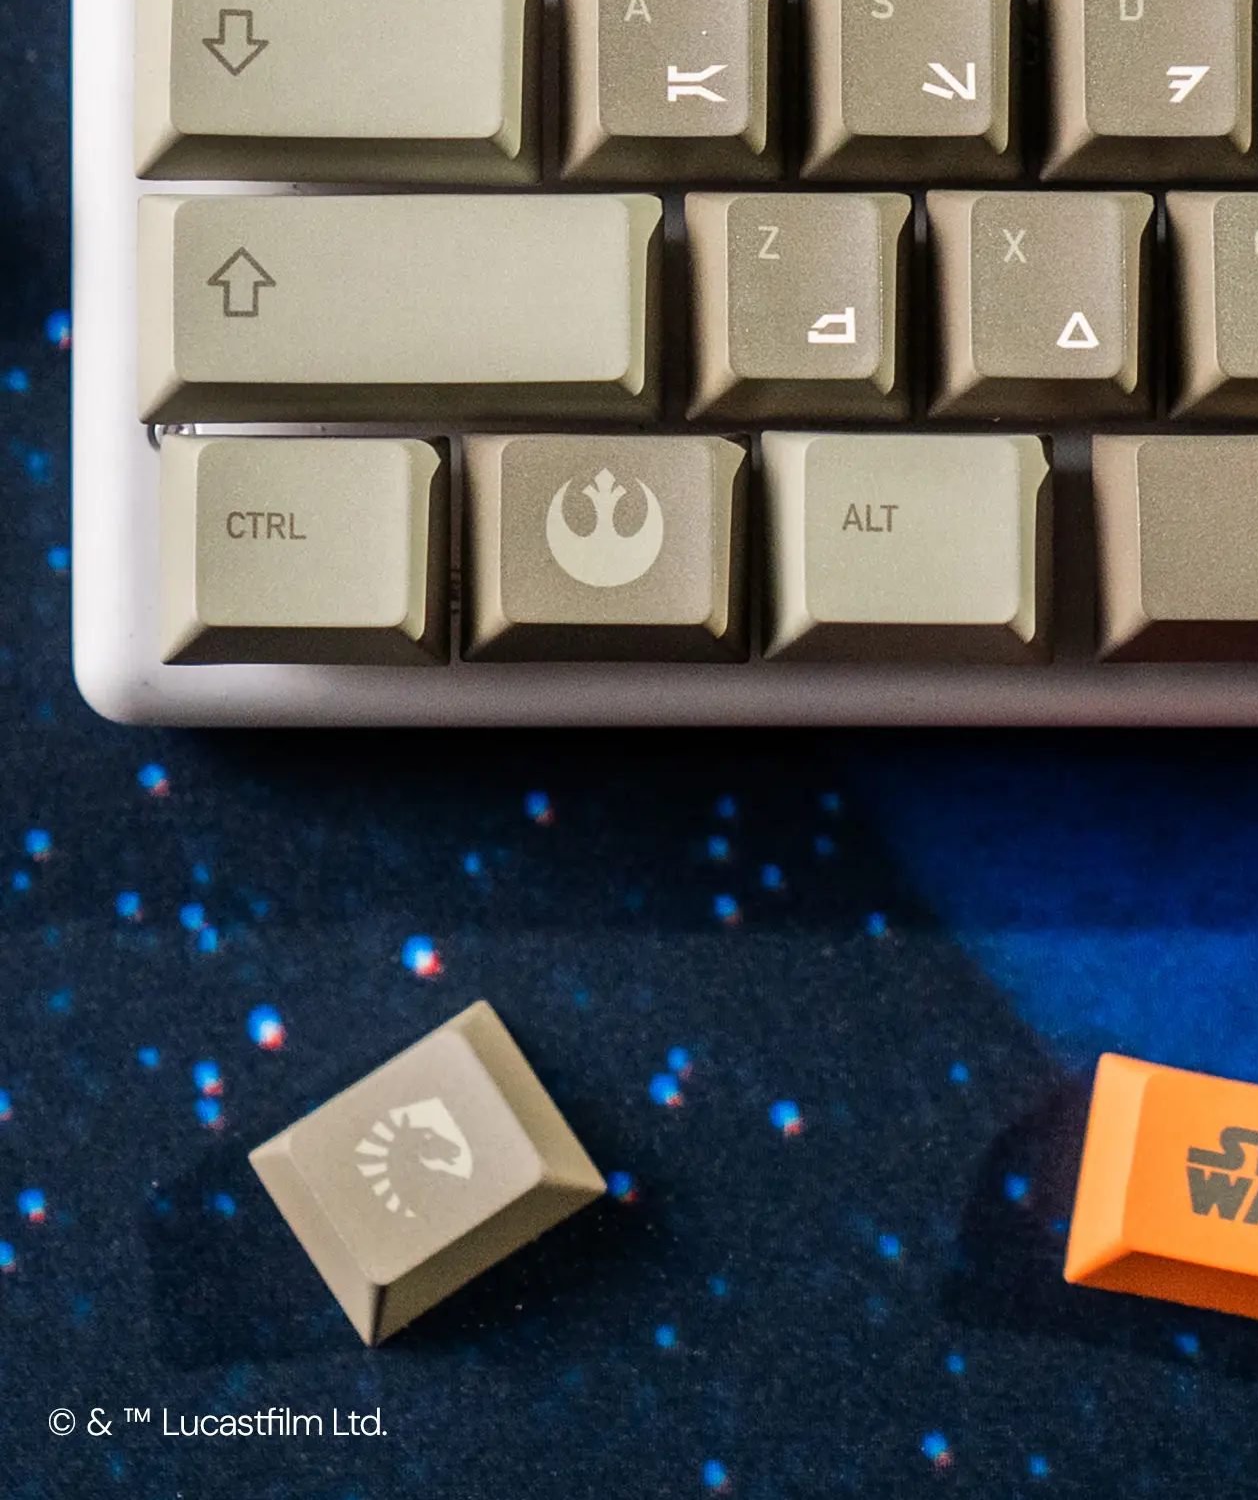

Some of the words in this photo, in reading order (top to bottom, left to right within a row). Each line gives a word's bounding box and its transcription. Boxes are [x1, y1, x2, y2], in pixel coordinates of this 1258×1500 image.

[758, 225, 780, 260] Z
[1002, 228, 1027, 263] X
[225, 510, 308, 542] CTRL
[841, 503, 899, 533] ALT
